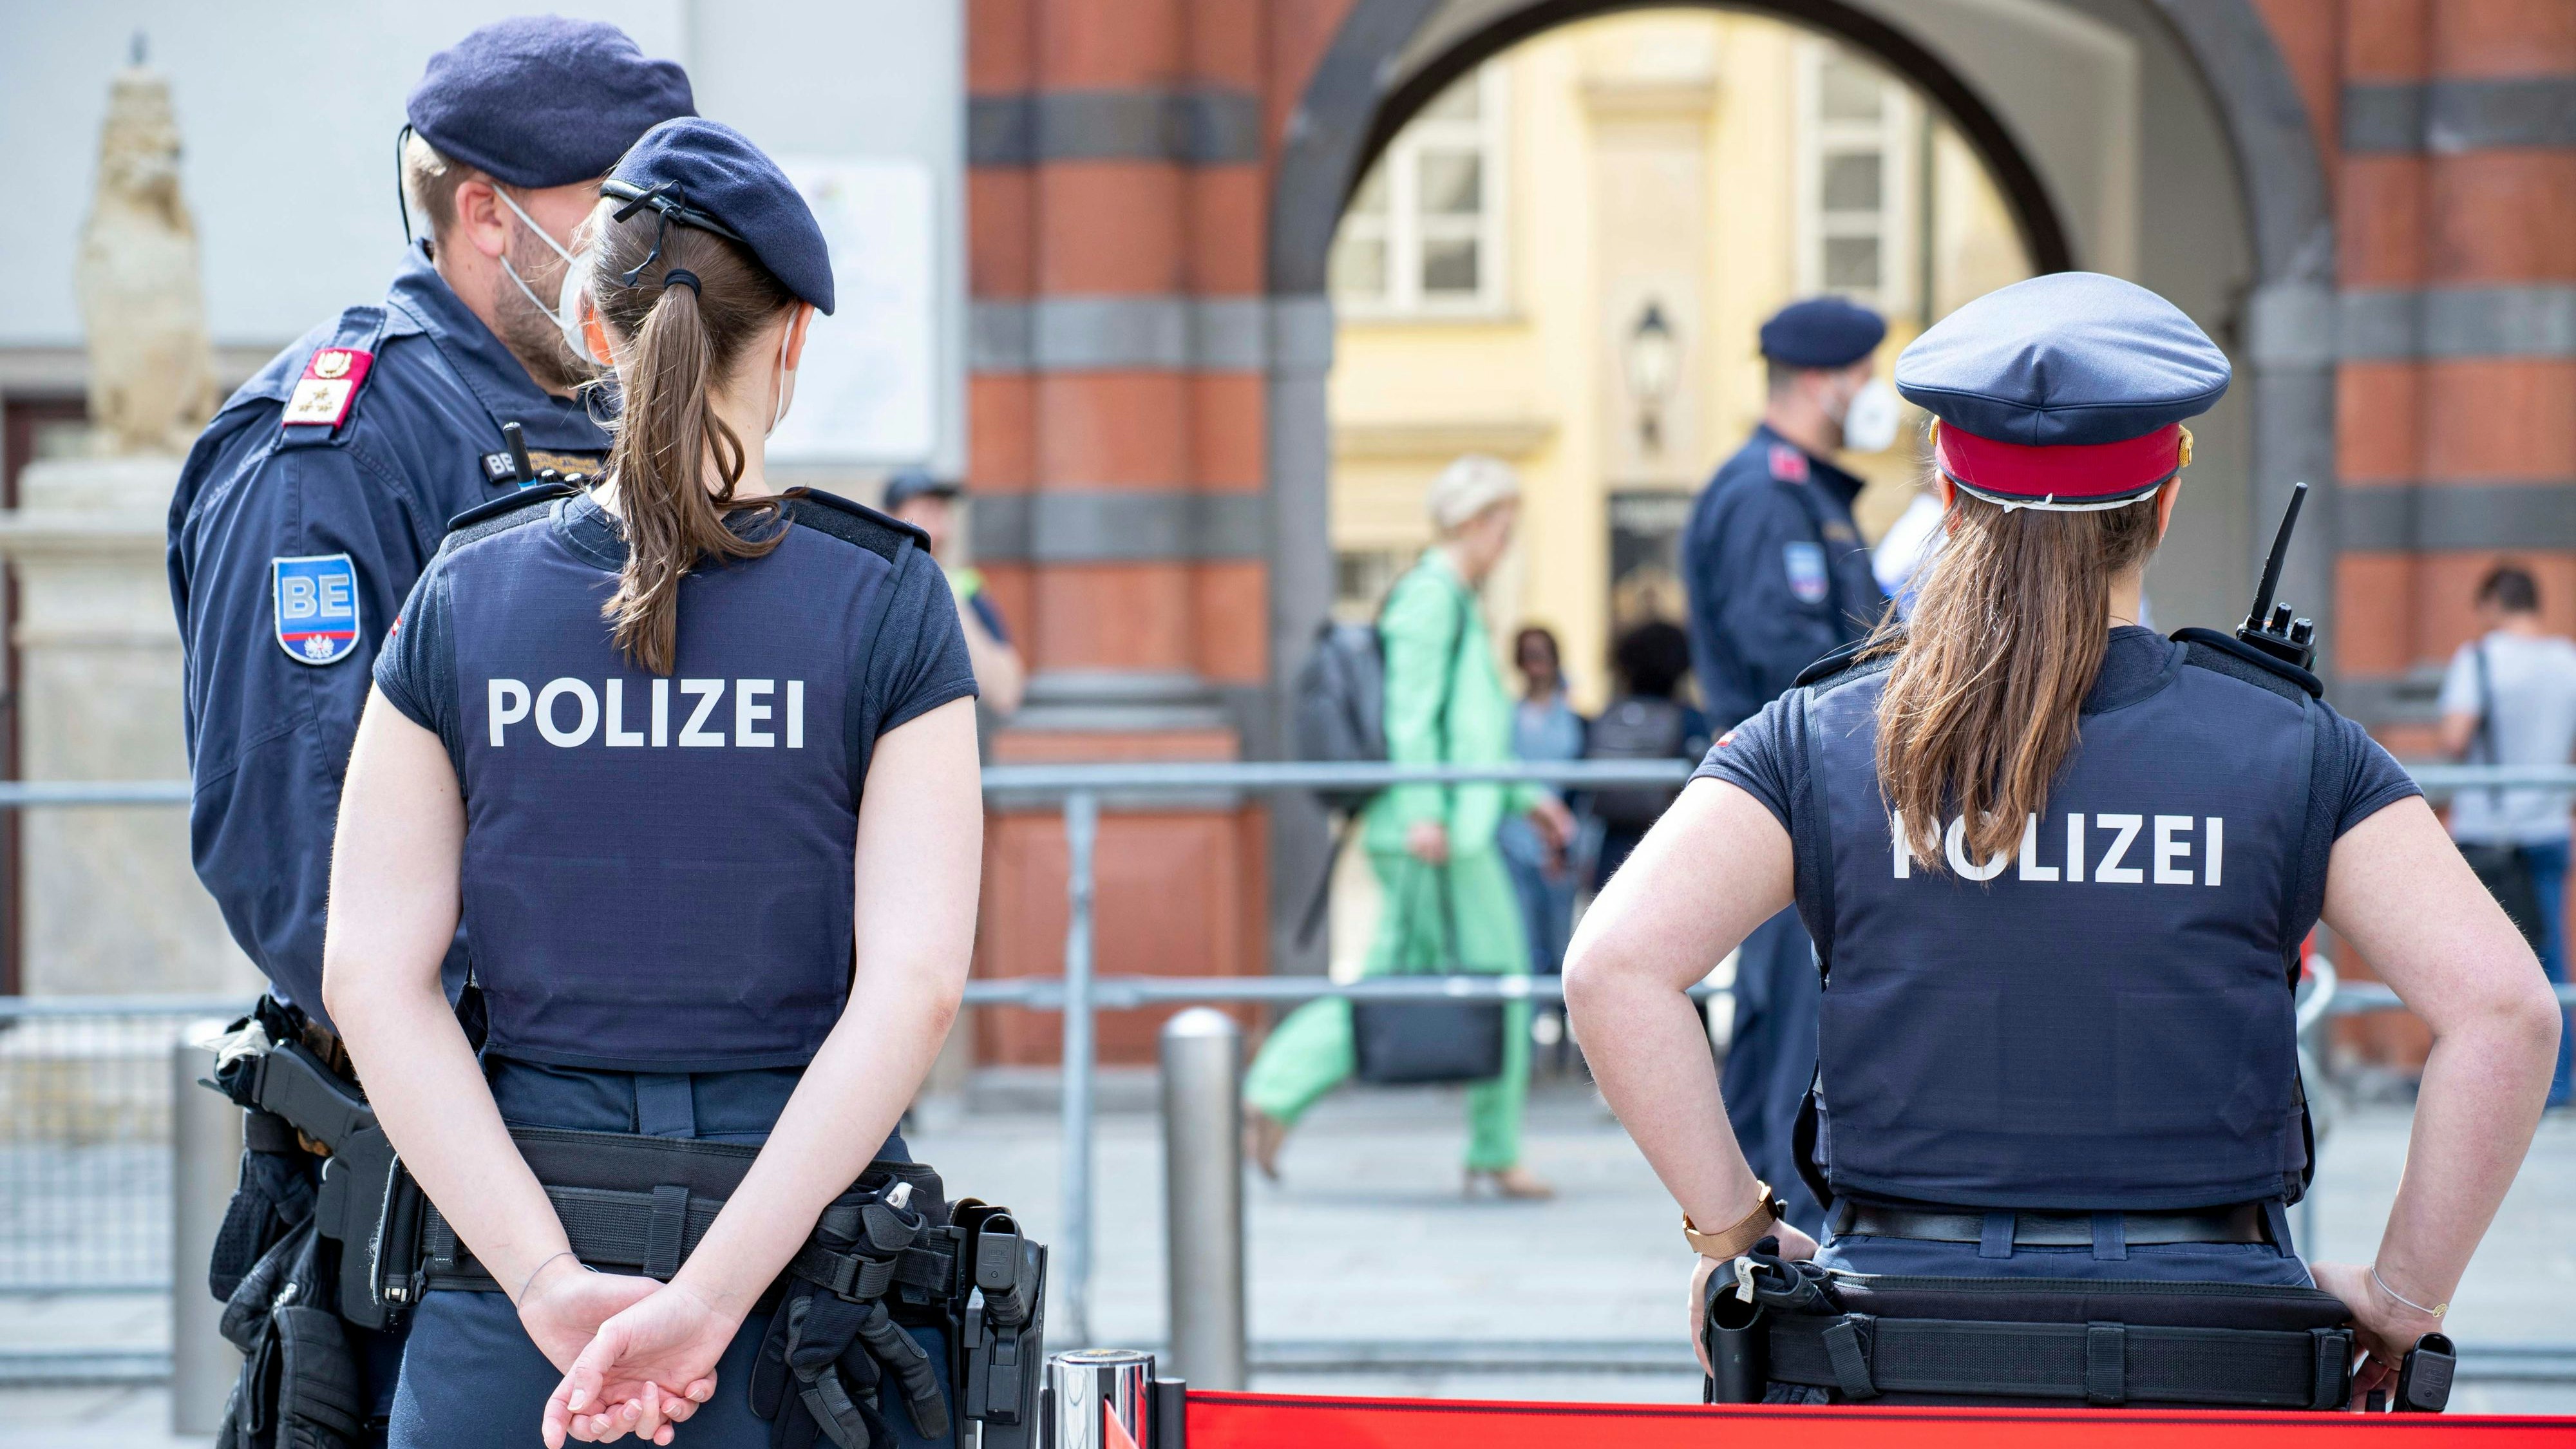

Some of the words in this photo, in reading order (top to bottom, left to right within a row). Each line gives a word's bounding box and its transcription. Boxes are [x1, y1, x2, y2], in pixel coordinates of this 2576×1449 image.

[282, 573, 352, 619] BE
[488, 677, 804, 748] POLIZEI
[1894, 810, 2222, 886] POLIZEI
